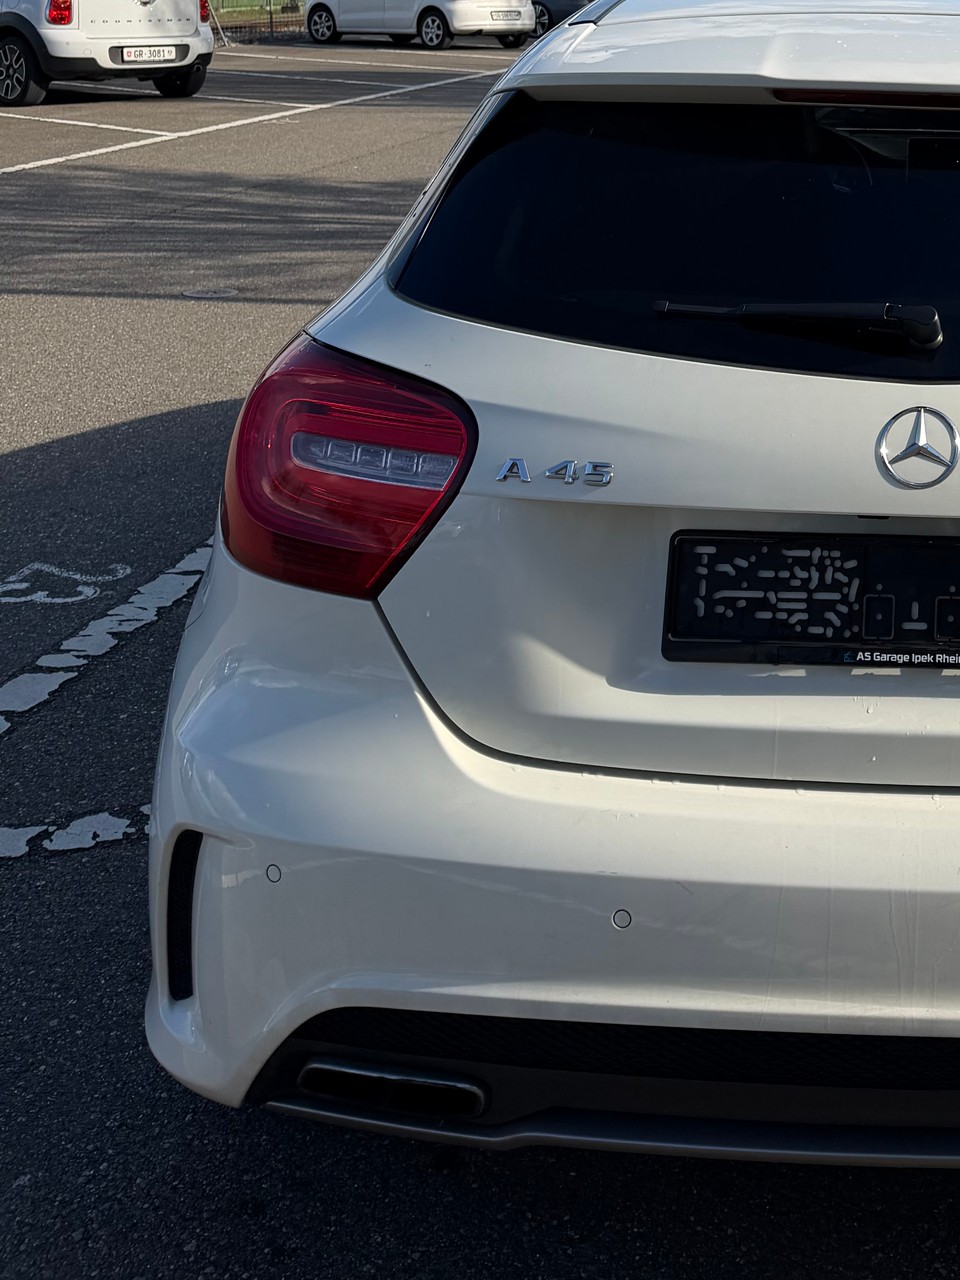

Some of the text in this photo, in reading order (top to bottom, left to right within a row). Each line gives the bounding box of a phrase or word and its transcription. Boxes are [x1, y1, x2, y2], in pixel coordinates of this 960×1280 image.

[495, 458, 615, 487] A 45
[856, 651, 872, 661] AS
[873, 652, 910, 663] Garage
[911, 653, 934, 664] Ipek
